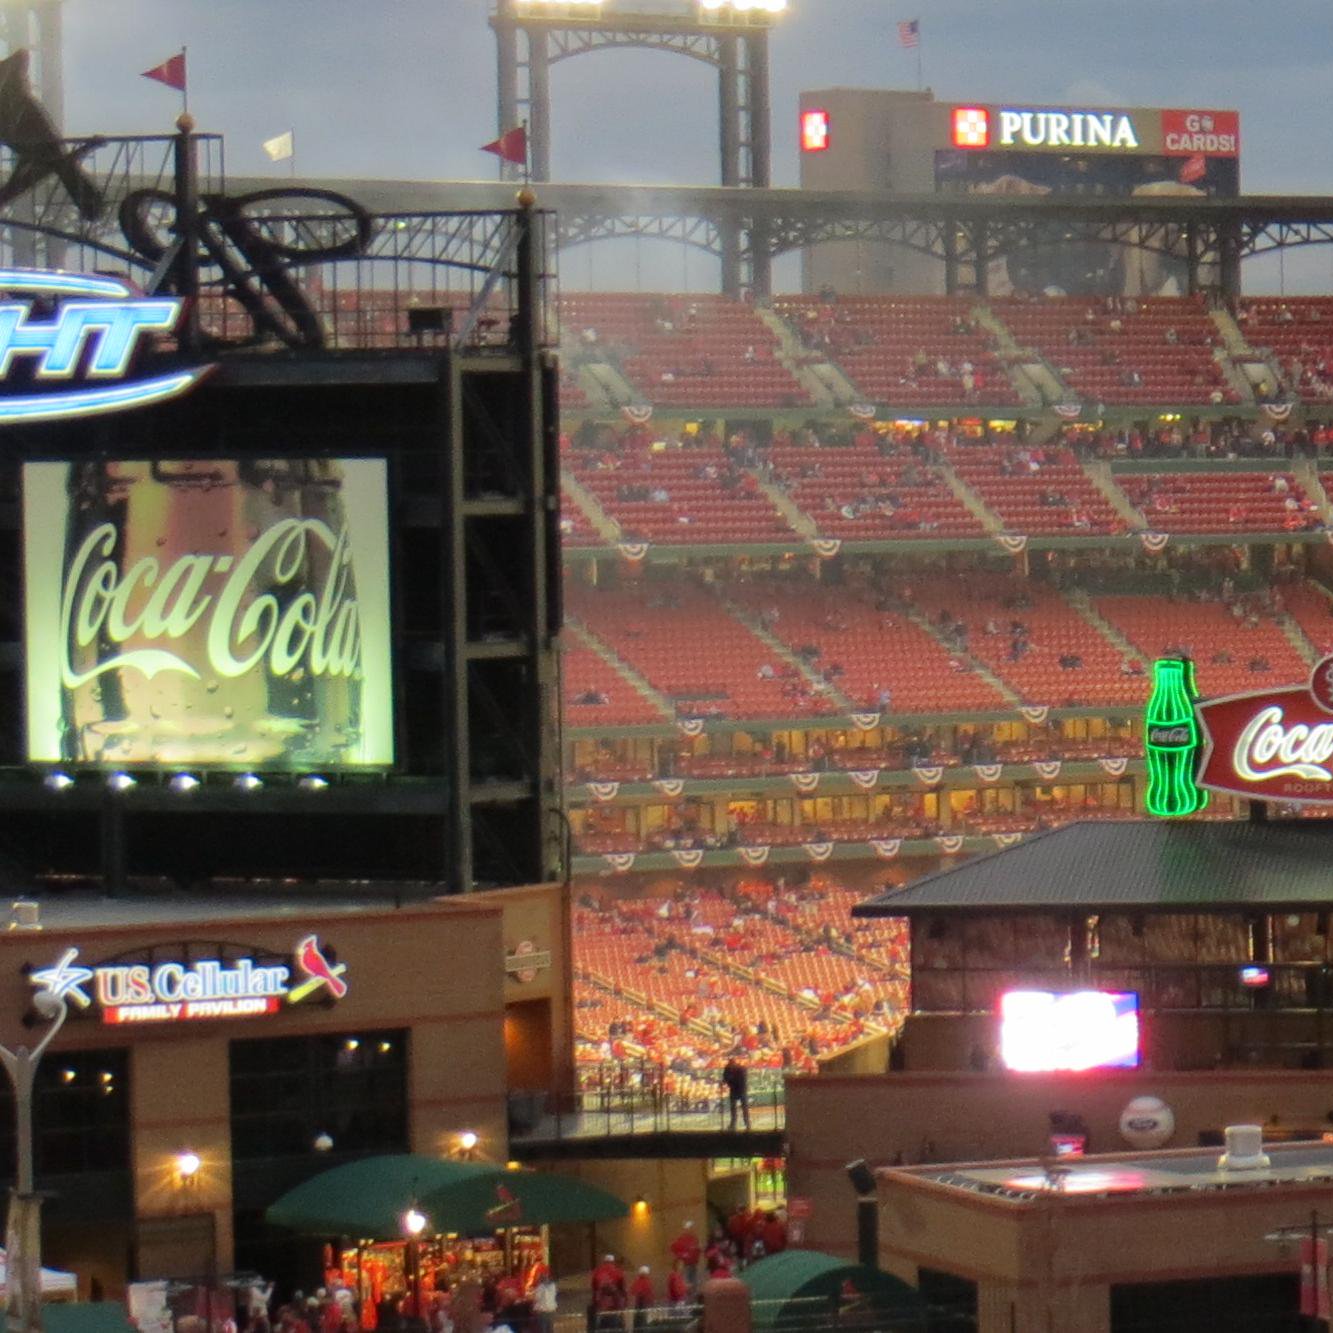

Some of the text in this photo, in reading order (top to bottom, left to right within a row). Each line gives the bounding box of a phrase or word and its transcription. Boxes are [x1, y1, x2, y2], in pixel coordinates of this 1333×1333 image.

[1000, 111, 1138, 148] PURINA
[1166, 132, 1236, 151] CARDS!
[61, 517, 361, 690] Coca-Cola
[118, 998, 267, 1022] FAMILY PAVILION
